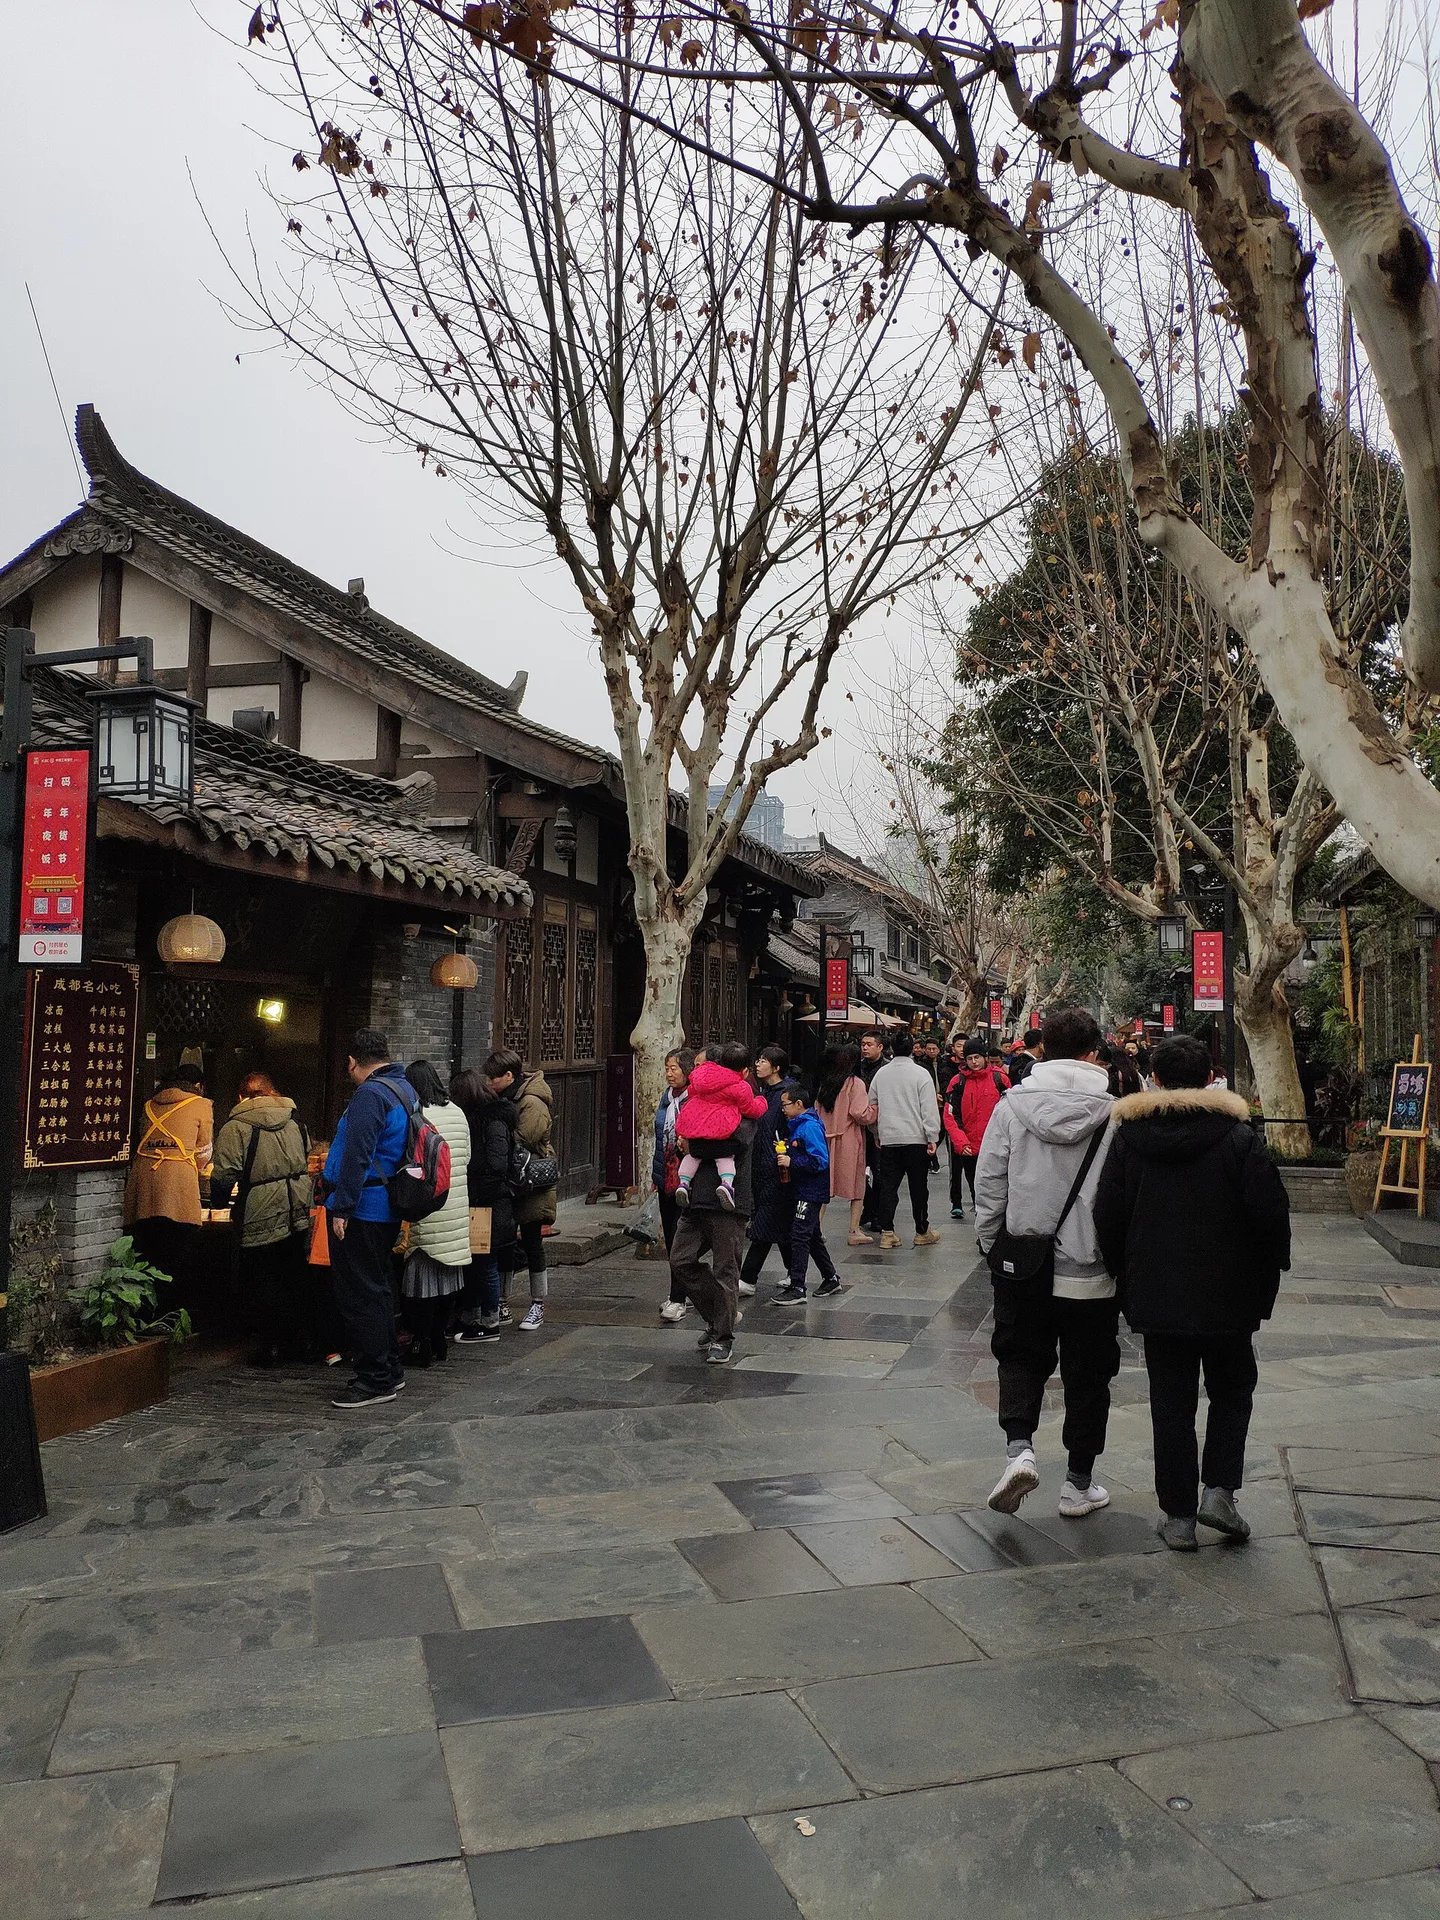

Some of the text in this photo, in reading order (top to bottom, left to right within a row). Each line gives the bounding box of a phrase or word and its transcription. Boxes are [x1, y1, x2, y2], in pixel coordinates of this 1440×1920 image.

[43, 776, 71, 788] 扫码
[53, 977, 122, 995] 成都名小吃
[44, 1003, 64, 1016] 凉面
[42, 1042, 72, 1054] 三大炮
[40, 1060, 71, 1072] 三合泥
[39, 1078, 70, 1090] 担担面
[85, 1077, 122, 1090] 粉蒸牛肉
[38, 1096, 69, 1108] 肥肠粉
[84, 1095, 122, 1107] 伤心凉粉
[38, 1115, 68, 1129] 煮凉粉
[83, 1112, 121, 1125] 夫妻肺片
